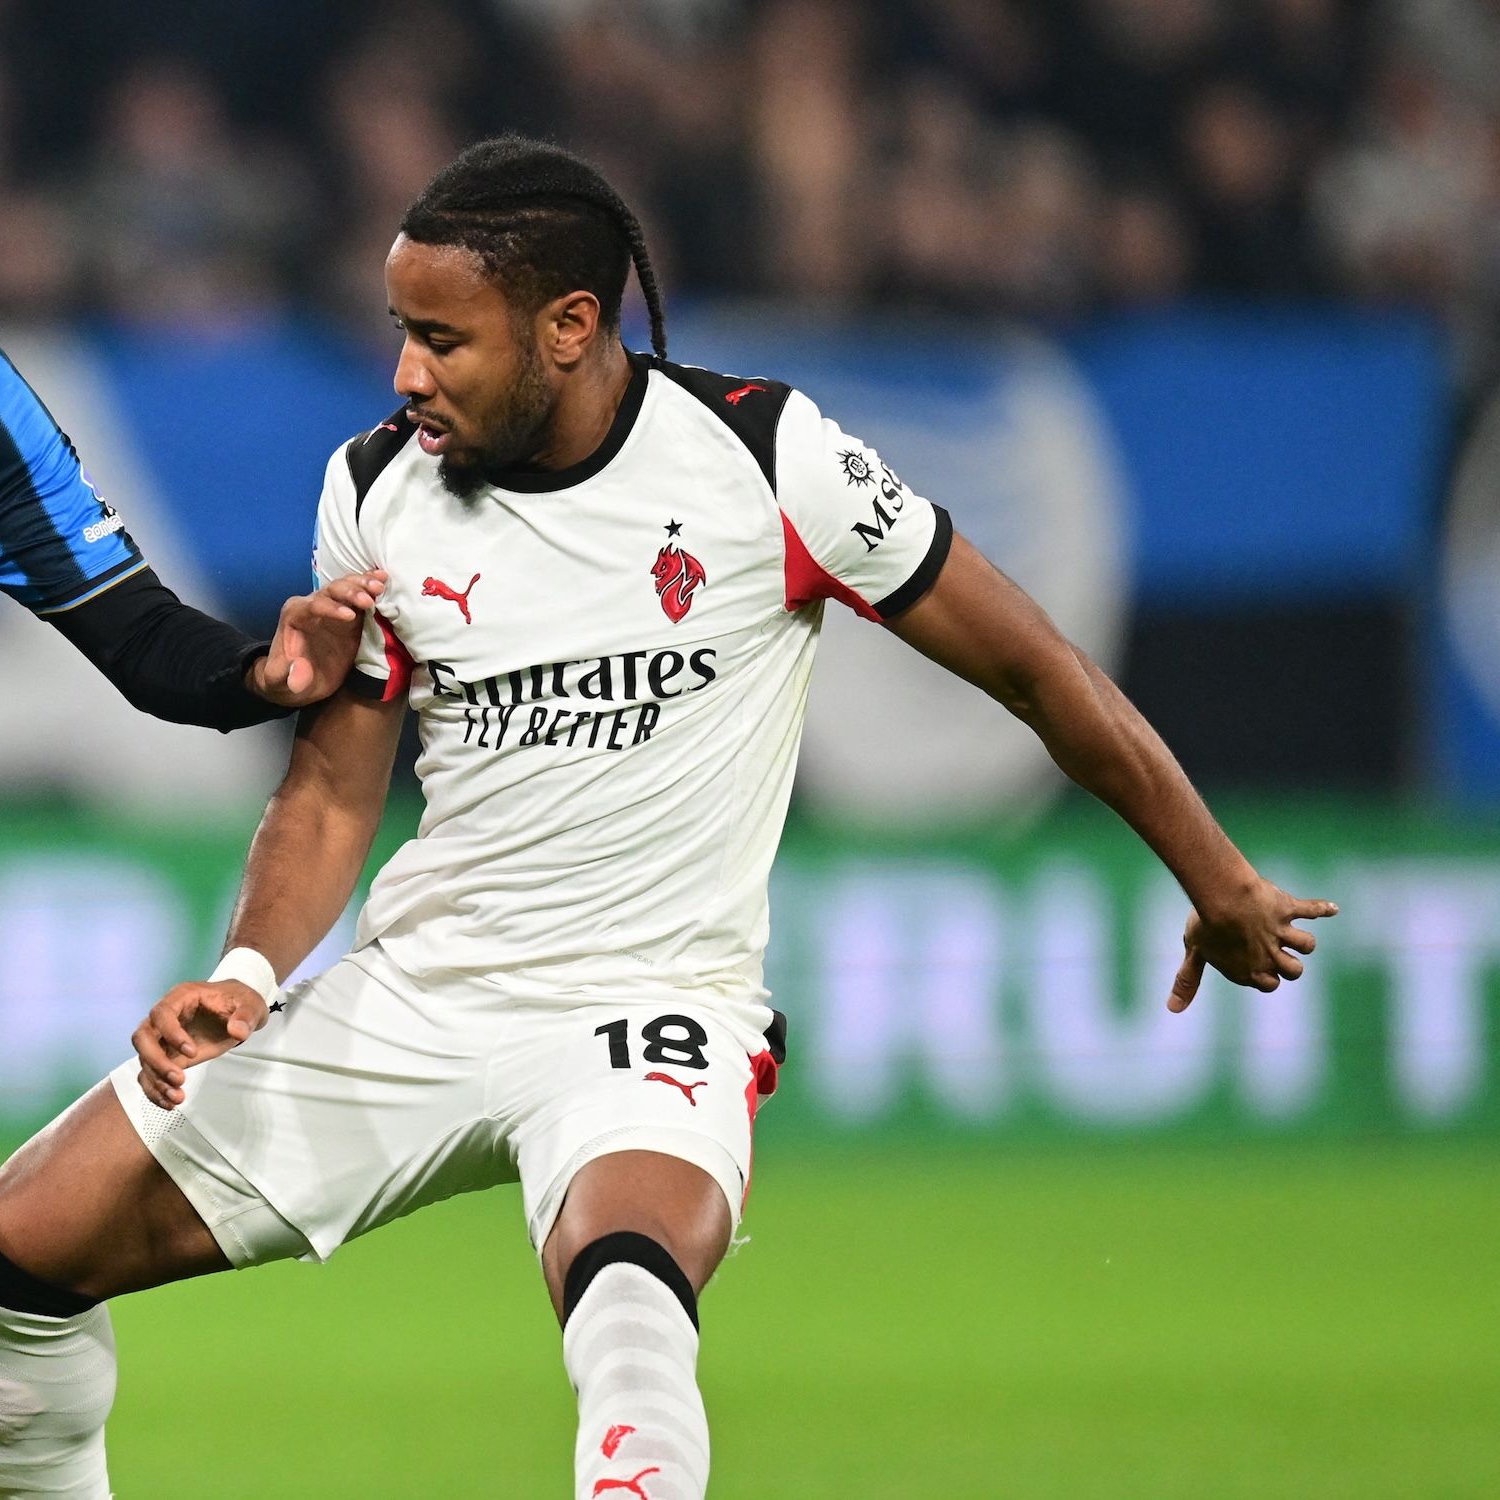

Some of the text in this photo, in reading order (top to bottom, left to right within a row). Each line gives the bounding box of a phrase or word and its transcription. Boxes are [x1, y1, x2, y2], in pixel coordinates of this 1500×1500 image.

[428, 648, 716, 706] Emirates
[463, 702, 661, 750] FLY BETTER
[594, 1014, 709, 1069] 18
